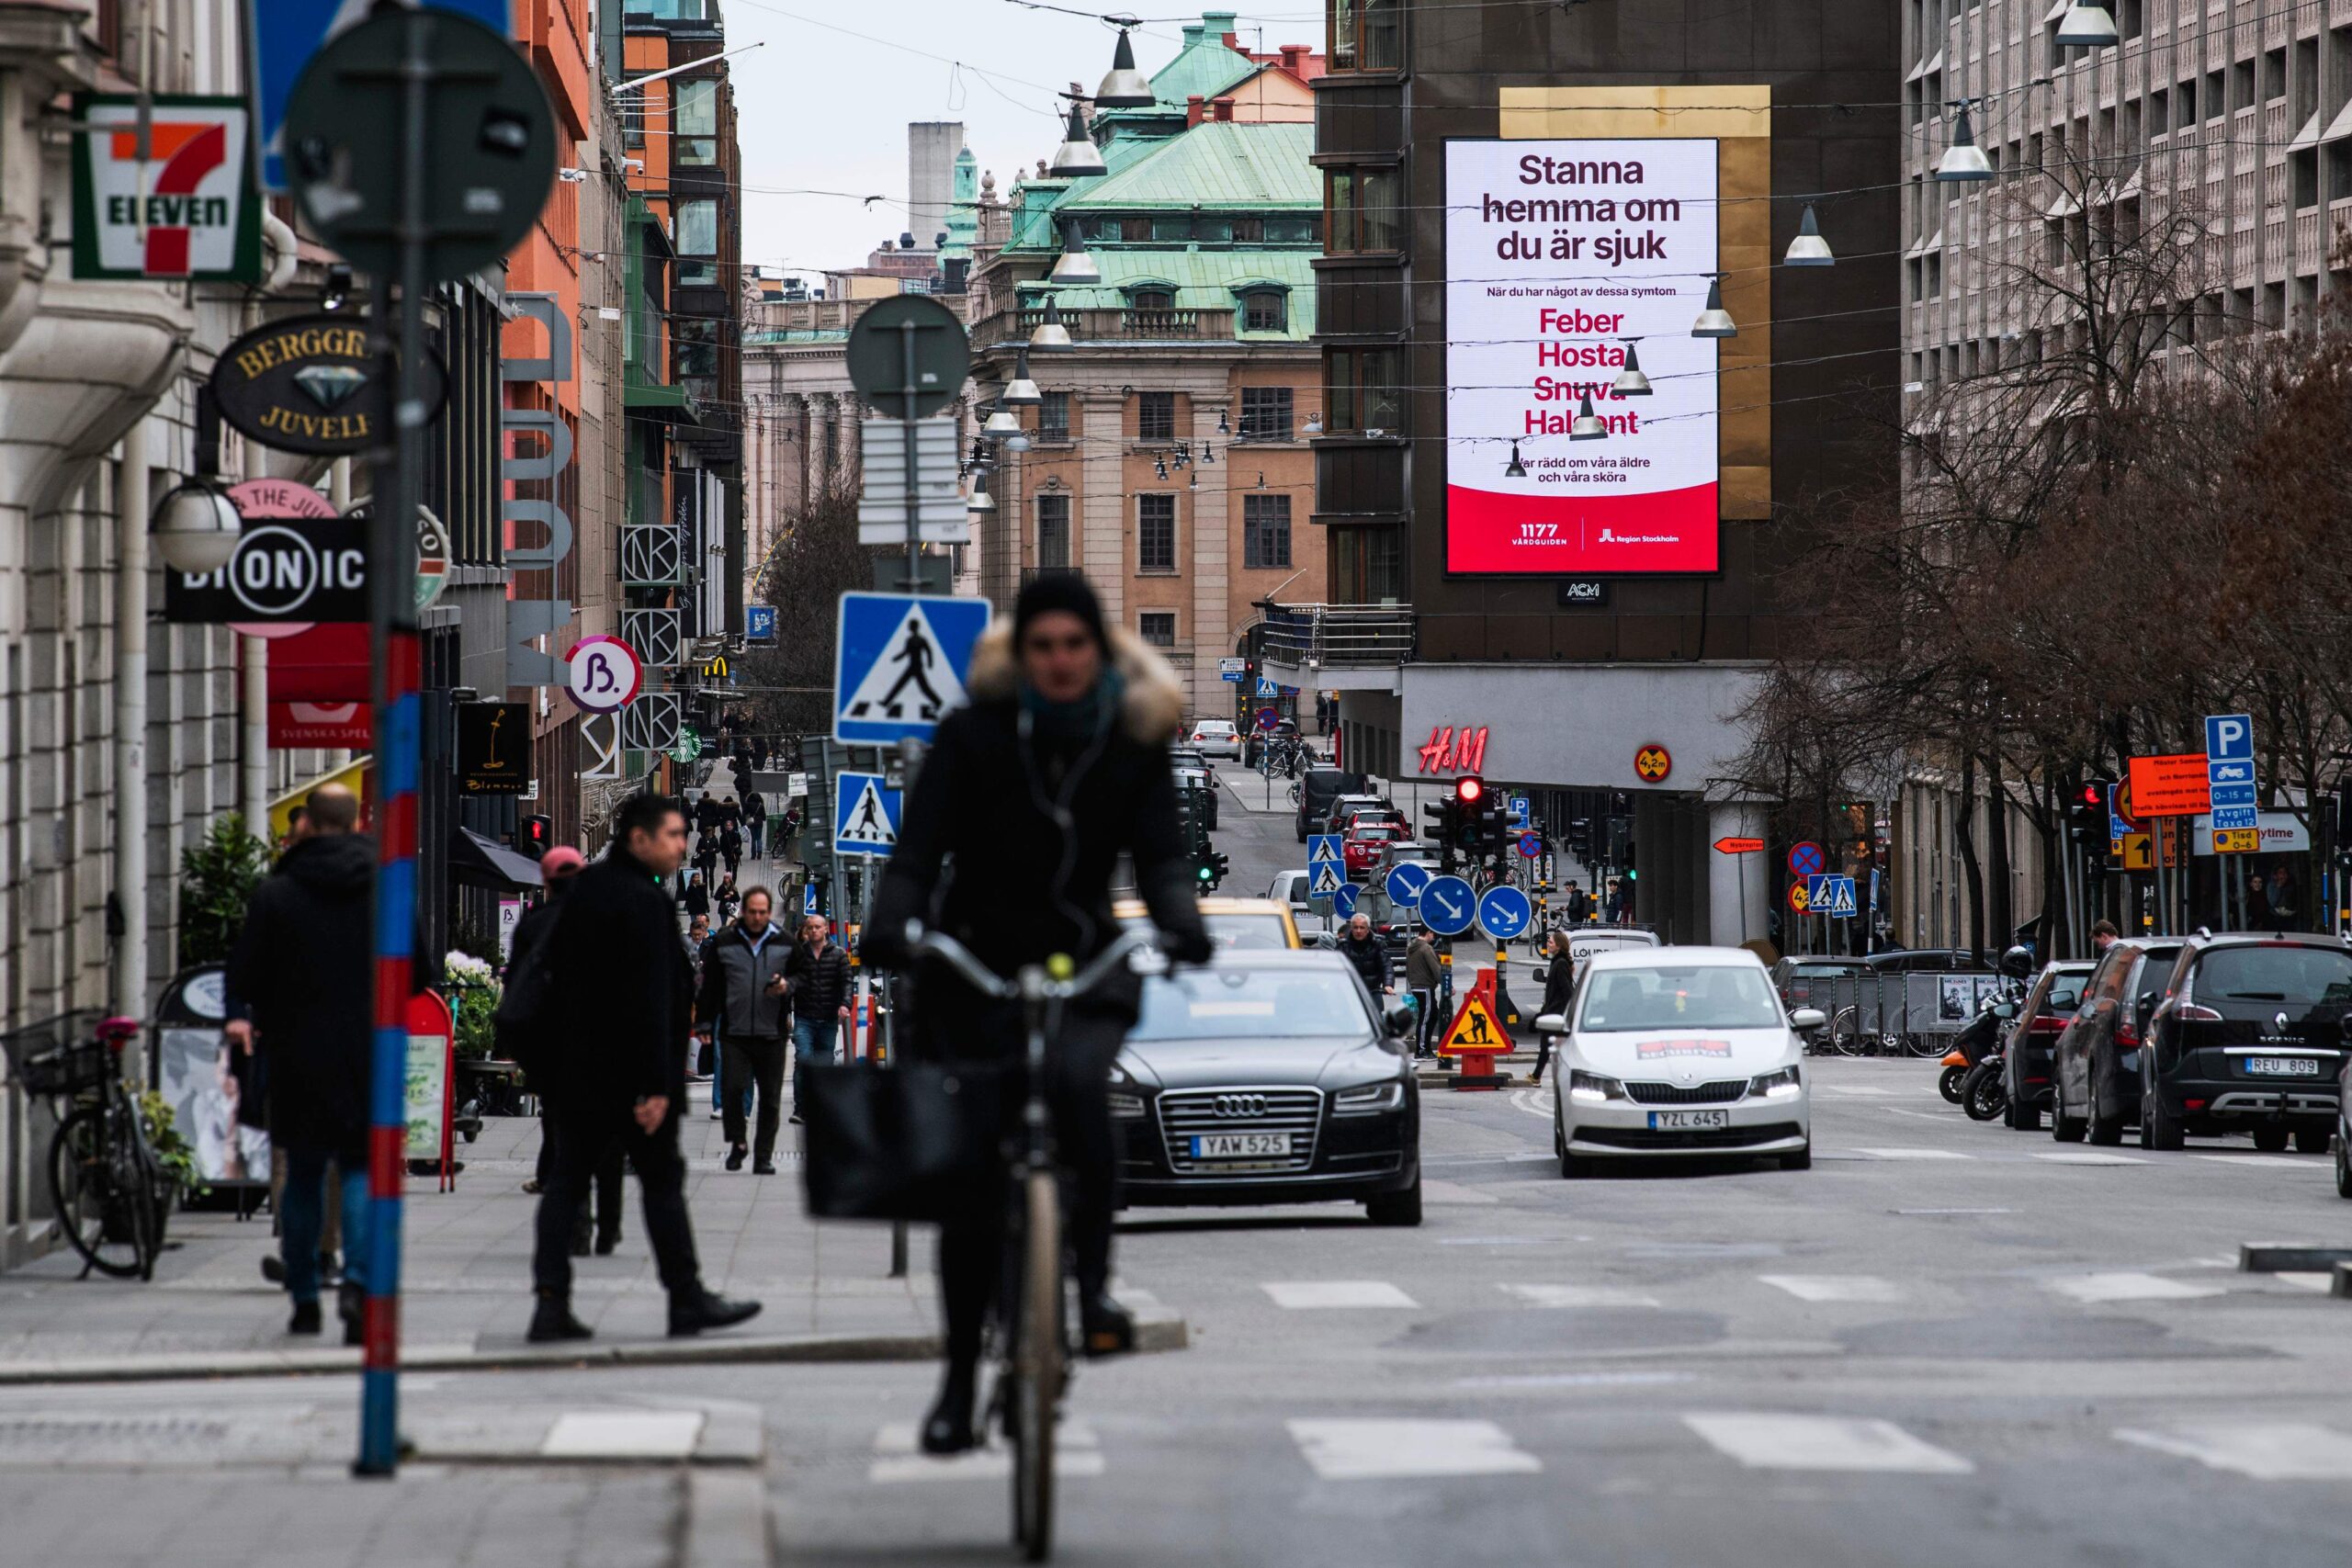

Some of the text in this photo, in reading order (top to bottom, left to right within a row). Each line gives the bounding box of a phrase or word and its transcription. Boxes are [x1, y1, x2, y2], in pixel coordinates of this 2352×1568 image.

[1519, 154, 1644, 185] Stanna
[1483, 193, 1680, 223] hemma om
[1497, 229, 1668, 267] du är sjuk
[1487, 286, 1507, 297] När
[1510, 287, 1523, 297] du
[1525, 287, 1544, 297] har
[1546, 285, 1578, 299] något
[1596, 287, 1628, 297] dessa
[1631, 287, 1676, 299] symtom
[1540, 309, 1624, 333] Feber
[1538, 343, 1625, 367] Hosta
[1525, 410, 1638, 434] Halnt
[1519, 456, 1650, 468] ar rädd om våra äldre
[1538, 470, 1626, 482] och våra sköra
[249, 489, 289, 504] THE
[1521, 524, 1558, 537] 1177
[1511, 536, 1567, 546] VÅRDGUIDEN
[1616, 536, 1641, 544] Region
[1567, 583, 1600, 597] ACM
[280, 728, 370, 739] SVENSKA SPEL
[2218, 720, 2244, 756] P
[1419, 726, 1488, 774] H&M
[1515, 800, 1526, 813] P
[2219, 808, 2251, 818] Avgift
[2216, 819, 2243, 829] Taxa
[2232, 831, 2252, 840] Tisd
[2259, 828, 2294, 840] ytime
[2254, 1059, 2315, 1072] REU 809
[1660, 1112, 1722, 1126] YZL 645
[1207, 1135, 1283, 1154] YAW 525
